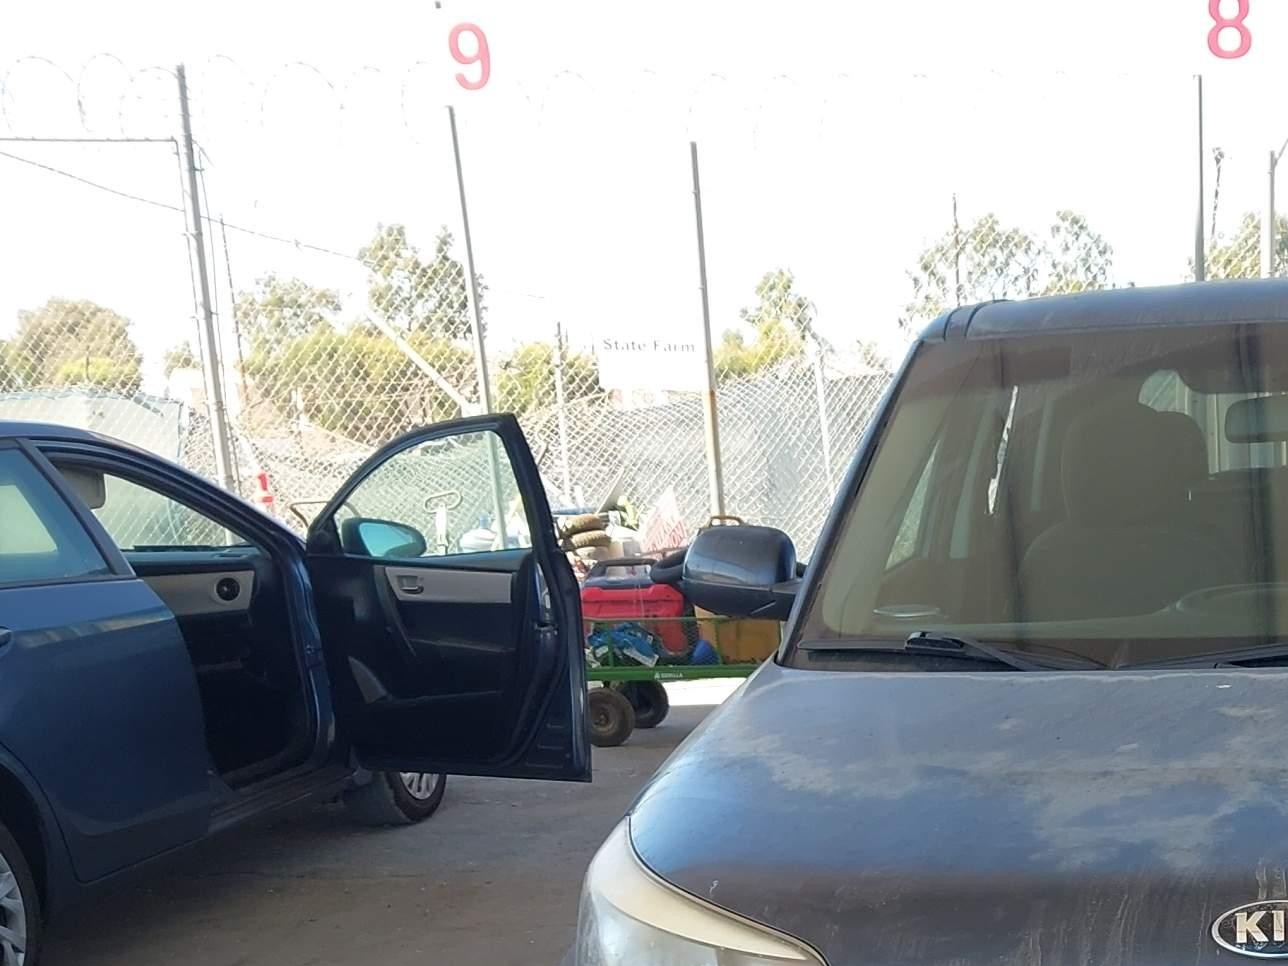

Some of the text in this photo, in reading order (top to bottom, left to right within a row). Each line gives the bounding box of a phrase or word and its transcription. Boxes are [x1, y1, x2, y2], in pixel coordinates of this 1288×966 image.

[448, 22, 490, 90] 9
[1208, 0, 1252, 59] 8
[603, 339, 696, 352] State Farm
